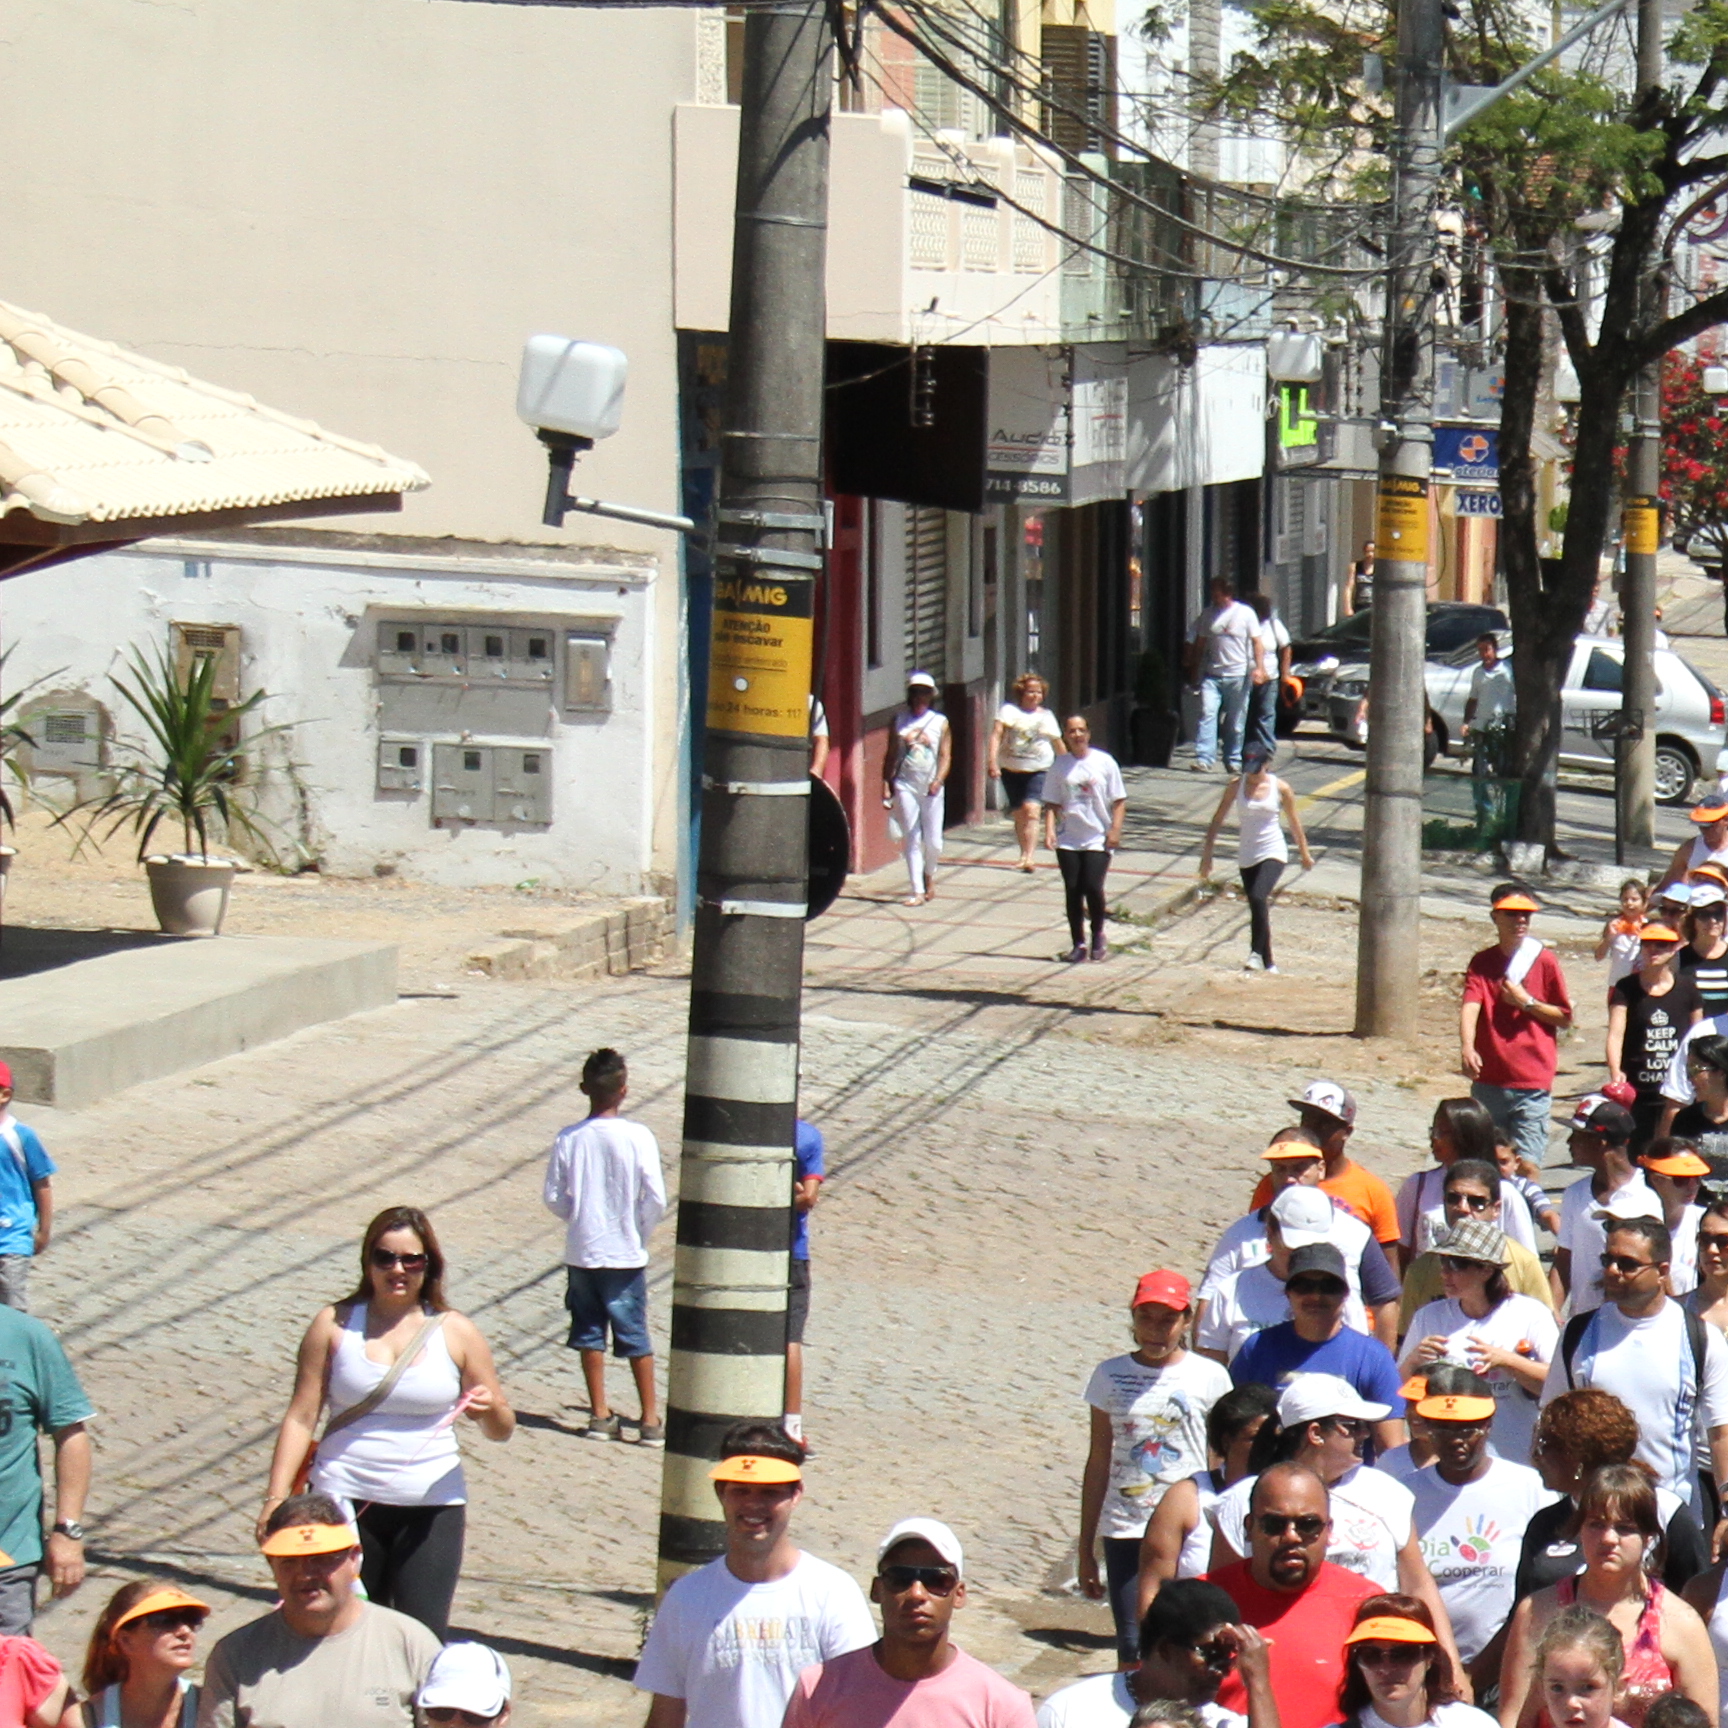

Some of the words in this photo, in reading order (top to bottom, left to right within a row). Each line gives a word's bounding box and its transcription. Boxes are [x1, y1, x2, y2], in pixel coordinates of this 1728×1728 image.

[1457, 493, 1500, 514] XERO
[1646, 1027, 1677, 1040] KEEP
[1645, 1040, 1679, 1052] CALM
[1646, 1059, 1672, 1070] LOV
